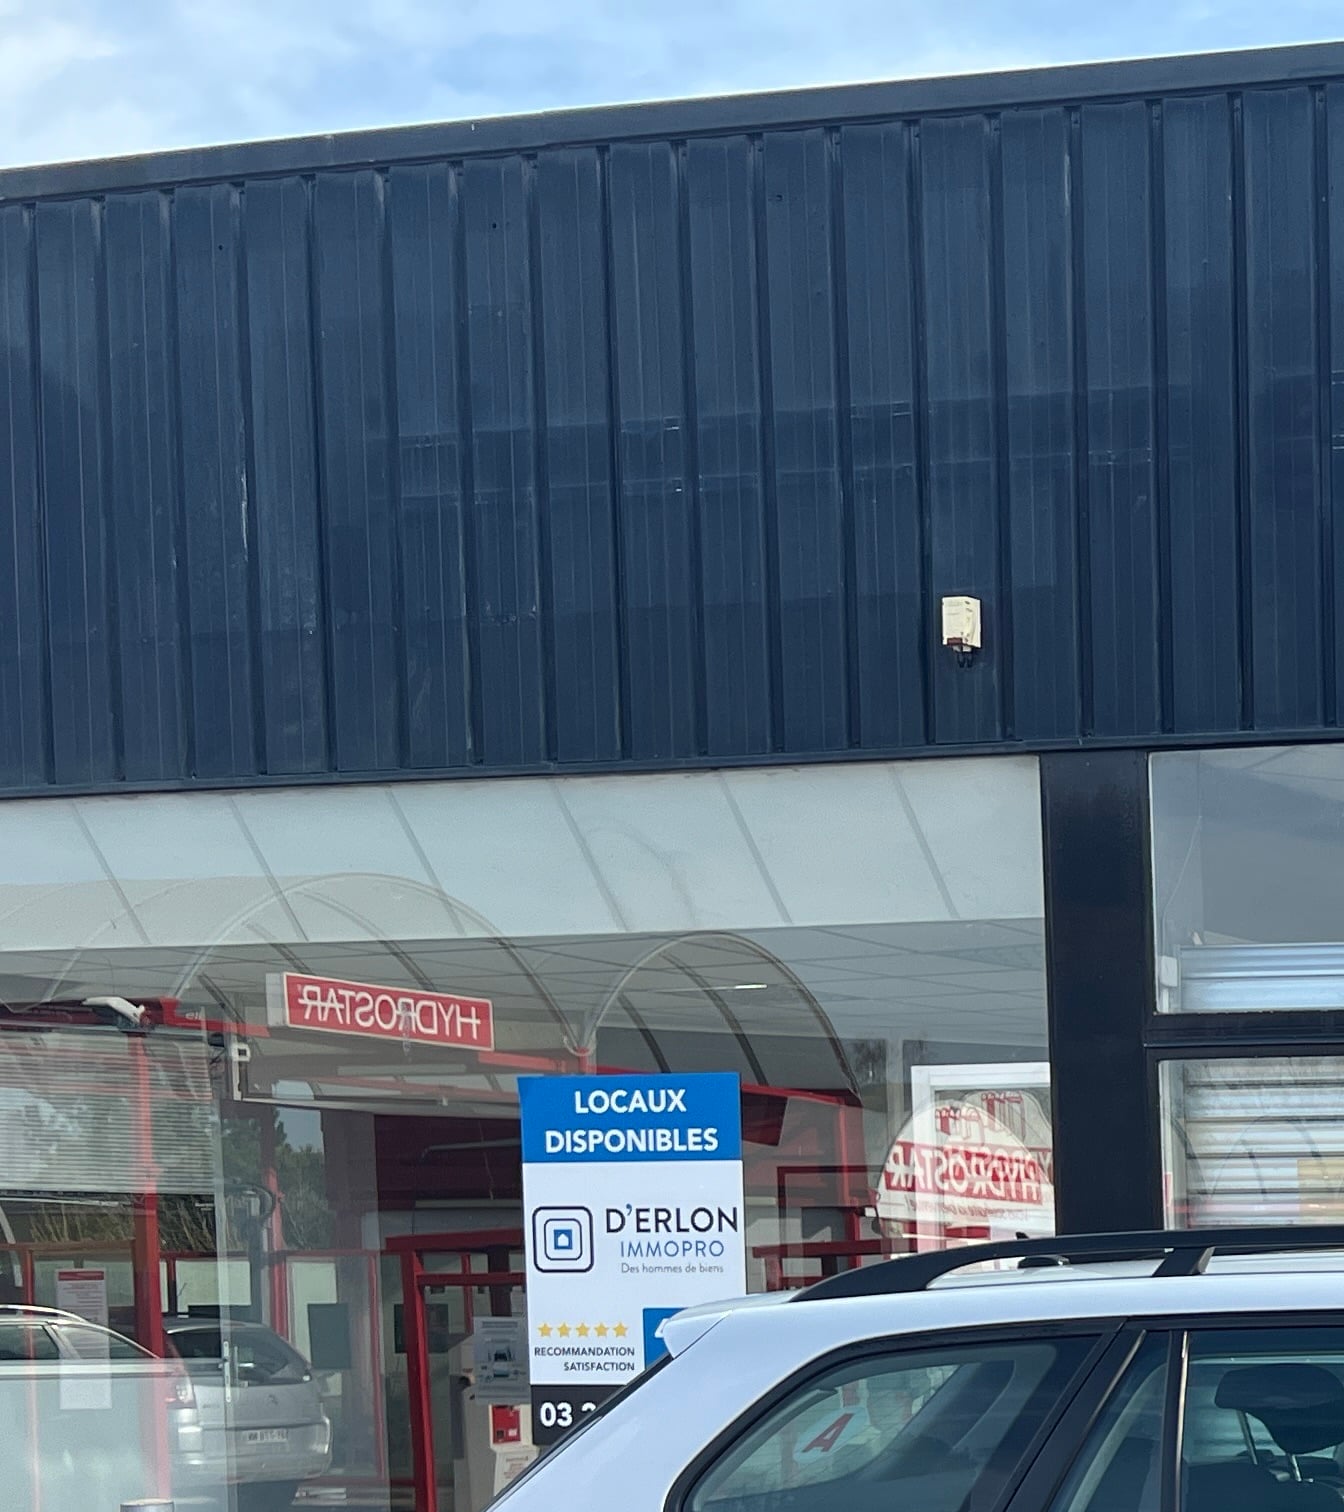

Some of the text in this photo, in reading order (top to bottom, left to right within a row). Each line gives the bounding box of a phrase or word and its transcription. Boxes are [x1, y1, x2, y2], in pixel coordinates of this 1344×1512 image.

[574, 1089, 687, 1114] LOCAUX
[545, 1128, 719, 1153] DISPONIBLES
[605, 1203, 739, 1234] D'ERLON
[620, 1240, 725, 1258] IMMOPRO
[621, 1262, 724, 1274] Des hommes de biens
[534, 1346, 636, 1357] RECOMMANDATION
[563, 1361, 636, 1372] SATISFACTION
[539, 1402, 573, 1427] 03
